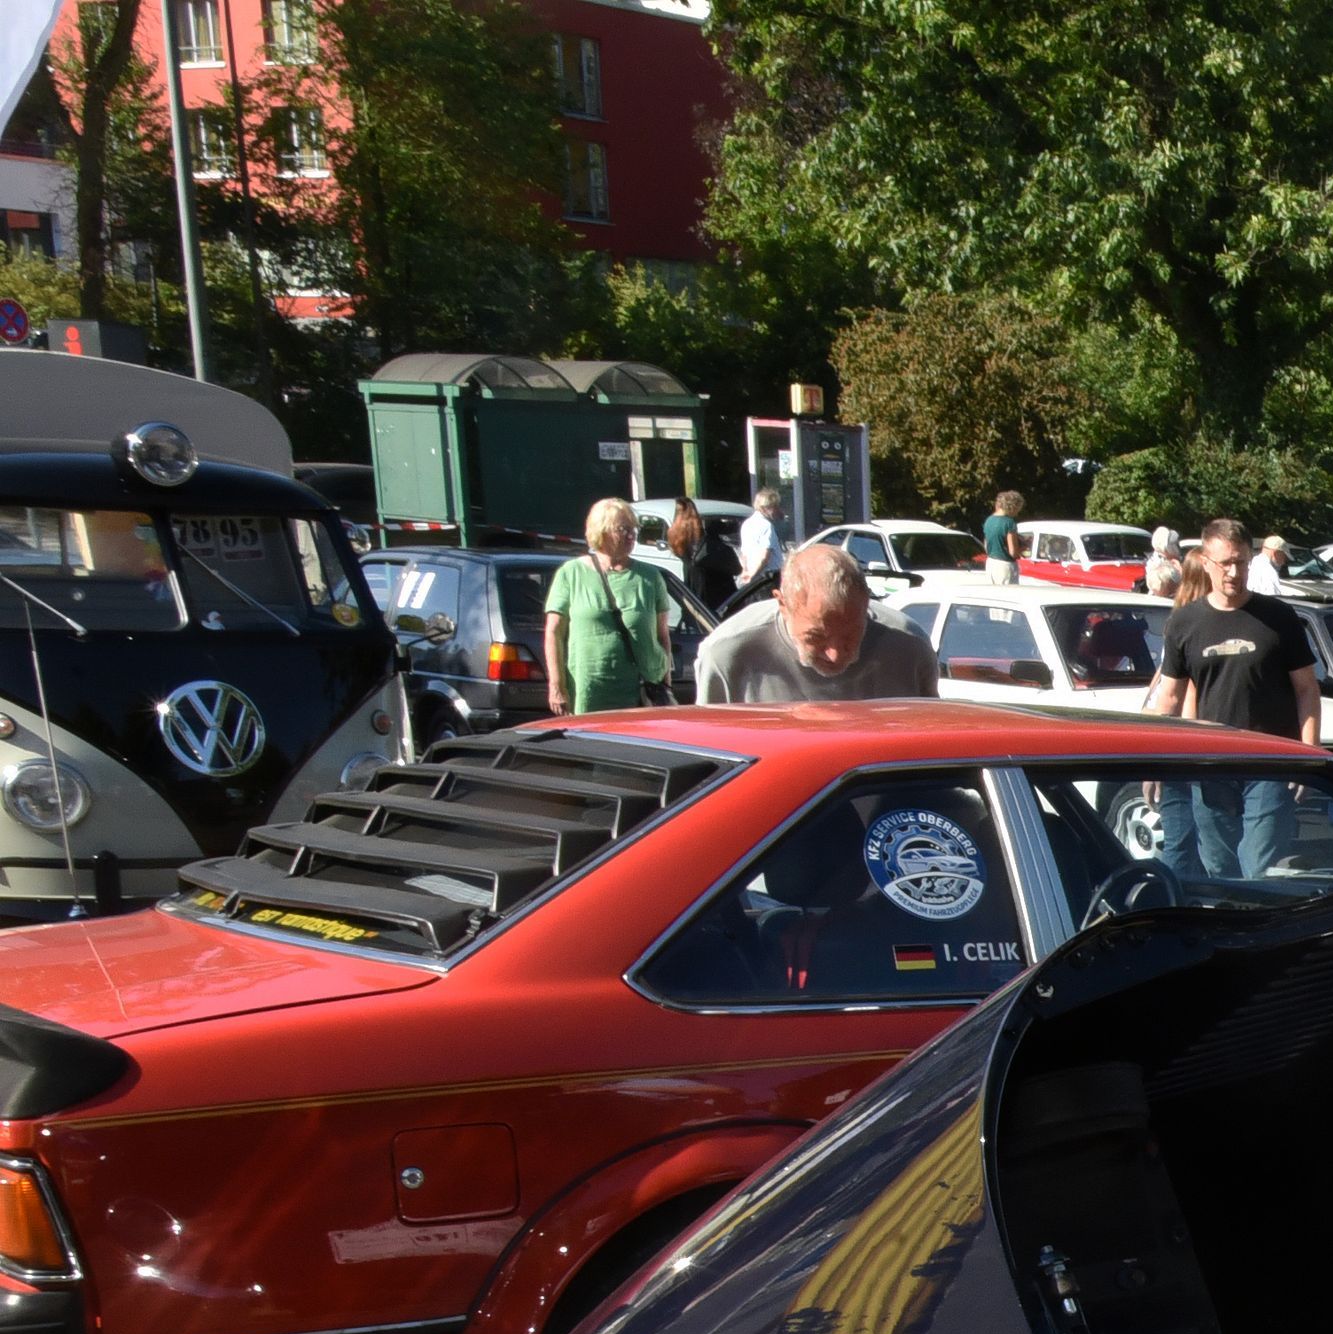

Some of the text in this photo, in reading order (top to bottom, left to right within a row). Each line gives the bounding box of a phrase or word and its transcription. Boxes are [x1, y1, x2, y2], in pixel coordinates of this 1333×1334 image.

[220, 518, 259, 547] 95
[867, 812, 977, 861] KFZ SERVICE OBERBERG
[893, 890, 929, 915] PREMIUM
[943, 942, 1020, 962] I. CELIK
